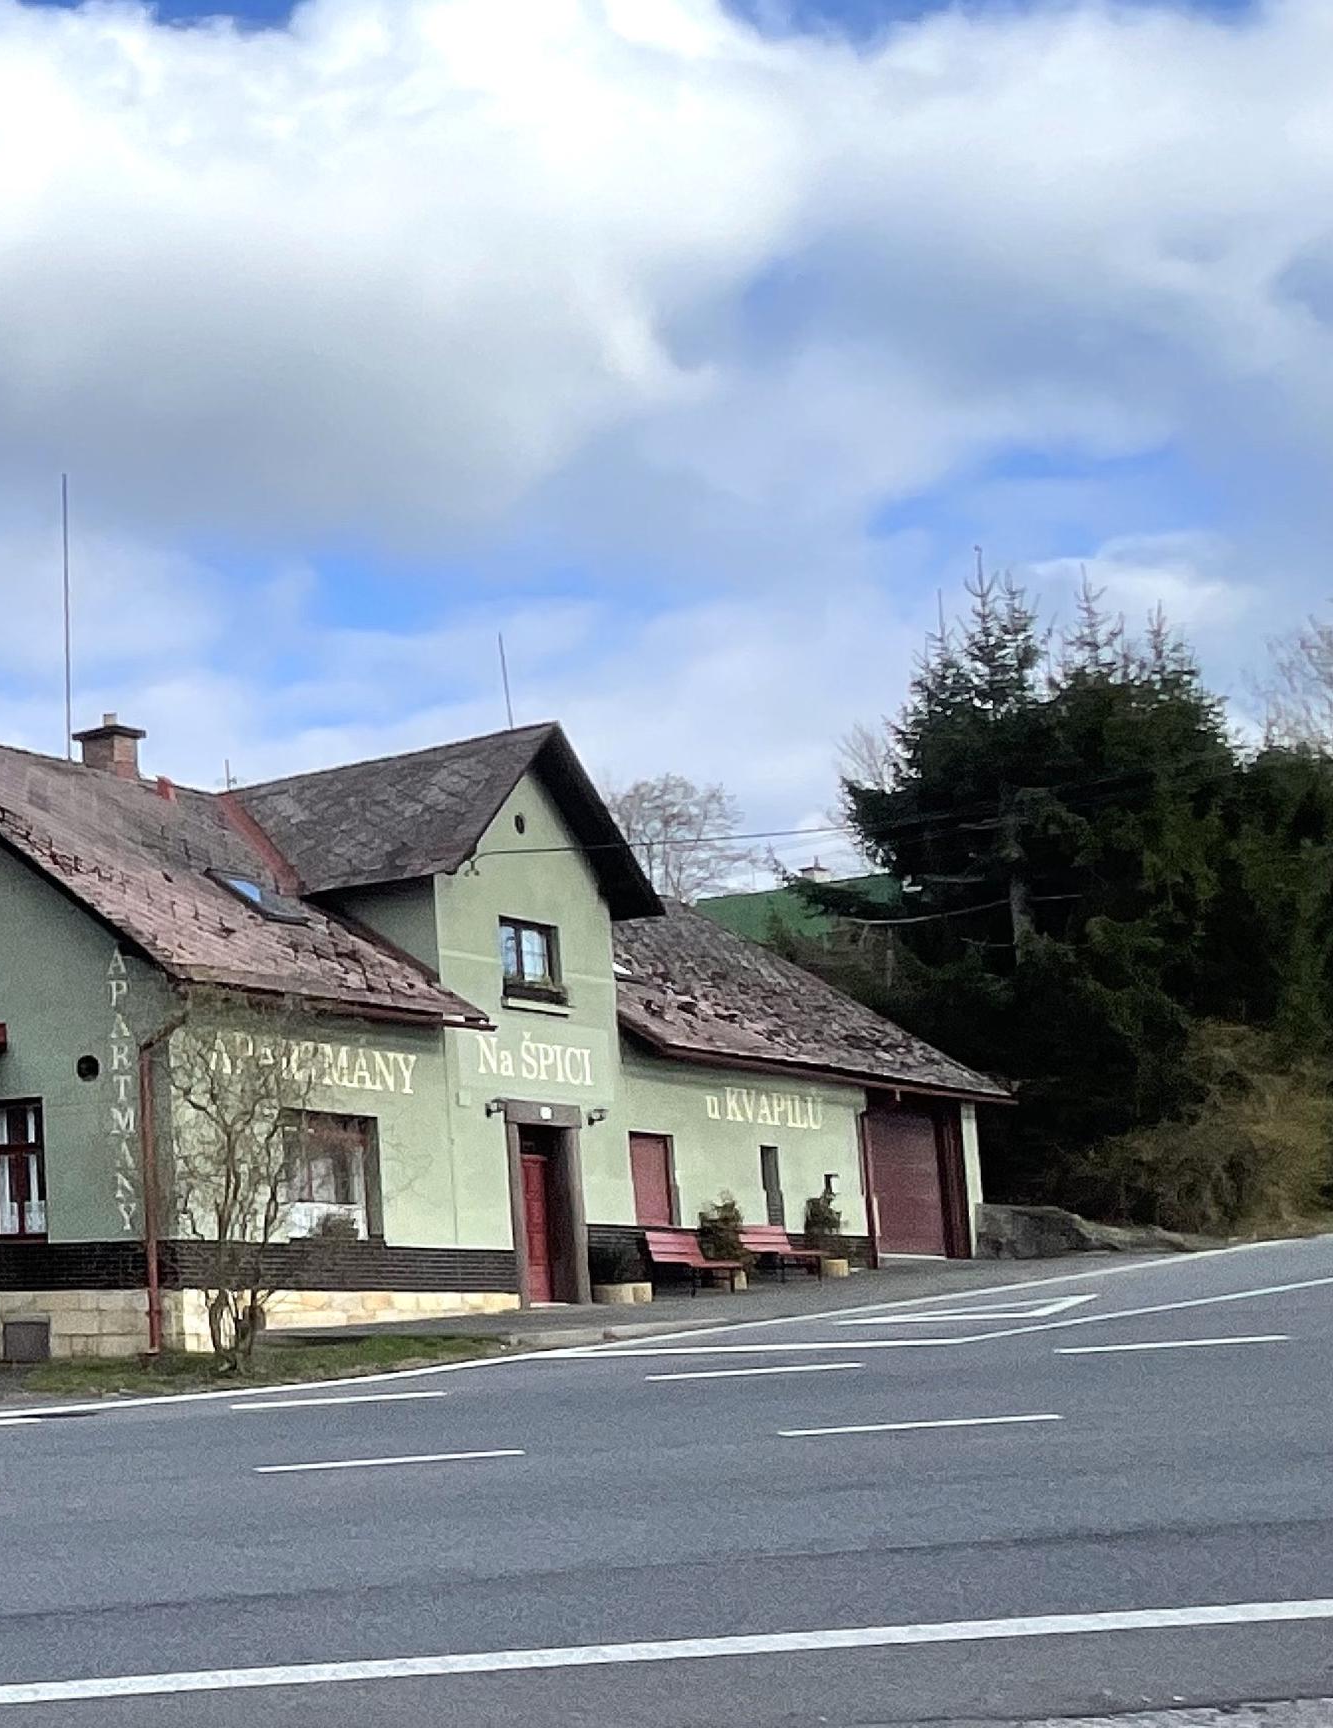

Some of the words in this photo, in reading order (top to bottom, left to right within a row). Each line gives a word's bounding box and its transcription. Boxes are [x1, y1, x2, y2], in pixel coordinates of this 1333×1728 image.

[107, 946, 135, 1231] APARTMANY
[475, 1034, 515, 1078] Na
[521, 1031, 594, 1086] ŠPICI
